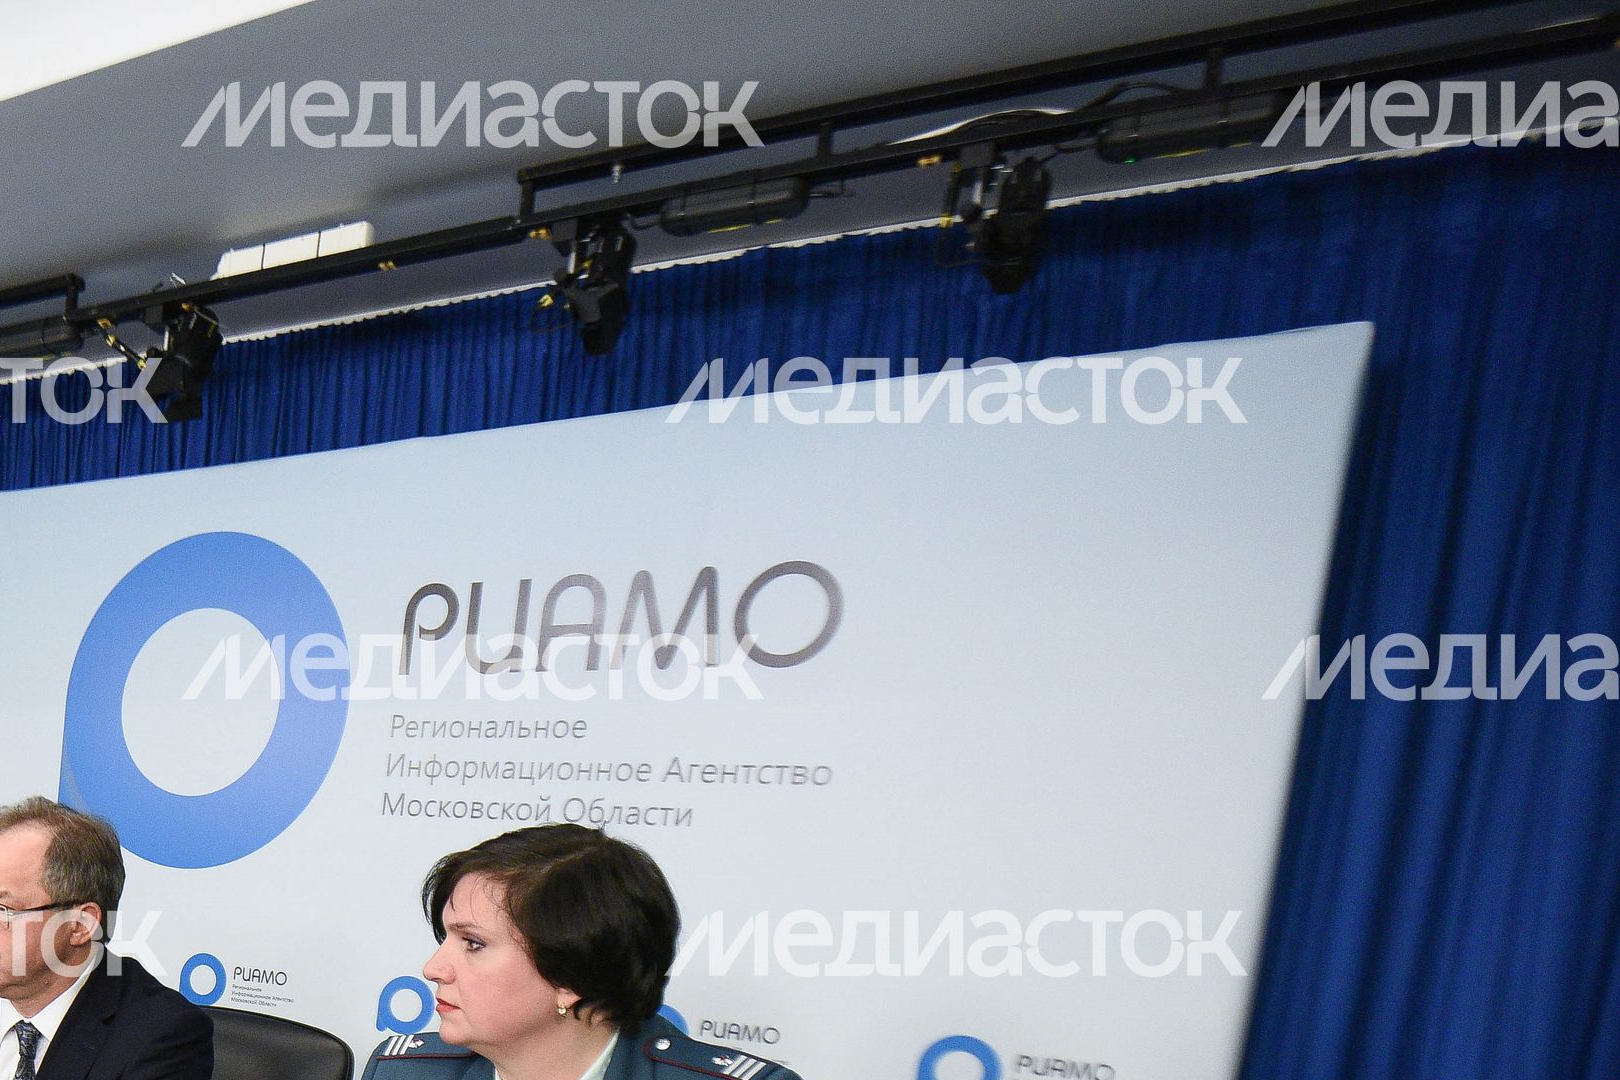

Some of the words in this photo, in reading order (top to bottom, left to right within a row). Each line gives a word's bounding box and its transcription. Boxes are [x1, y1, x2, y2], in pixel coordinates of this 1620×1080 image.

[389, 714, 588, 740] Региональное
[385, 752, 653, 786] Информационное
[662, 756, 834, 787] Агентство
[381, 791, 551, 823] Московской
[562, 797, 694, 828] Области
